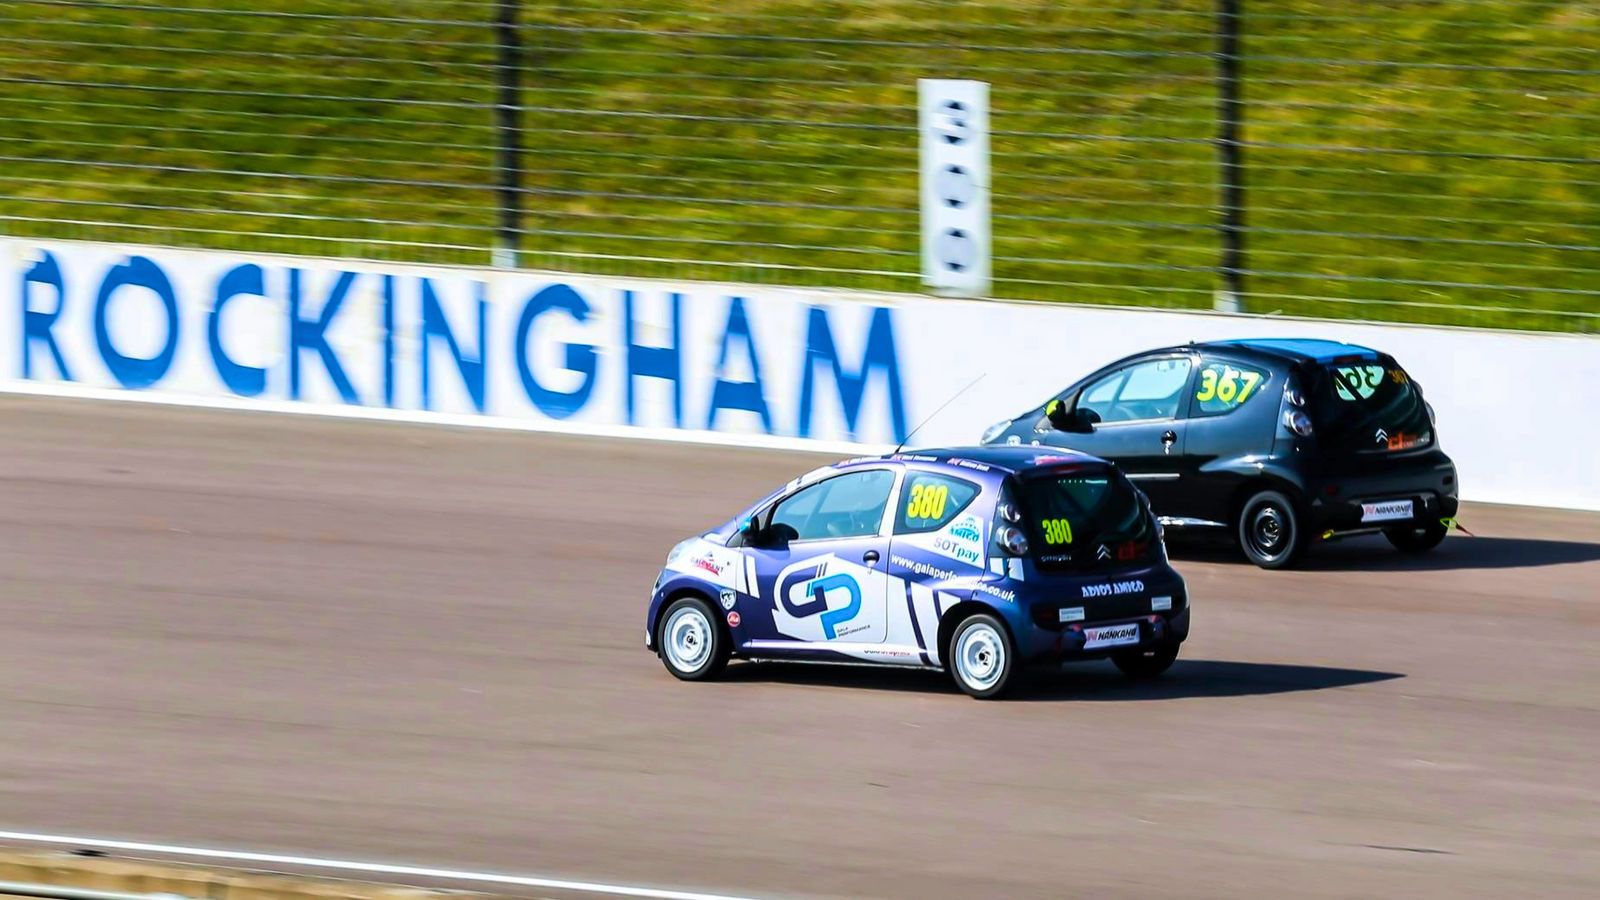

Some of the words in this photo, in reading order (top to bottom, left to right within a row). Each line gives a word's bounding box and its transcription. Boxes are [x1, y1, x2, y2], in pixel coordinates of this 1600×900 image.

[20, 248, 908, 445] ROCKINGHAM
[1196, 365, 1261, 403] 367
[907, 483, 949, 519] 380
[934, 537, 980, 563] SOTpay
[1042, 518, 1073, 545] 380
[891, 554, 1016, 603] www.galaperfonce.co.uk
[1081, 583, 1113, 598] ADIOS
[780, 562, 862, 640] GP
